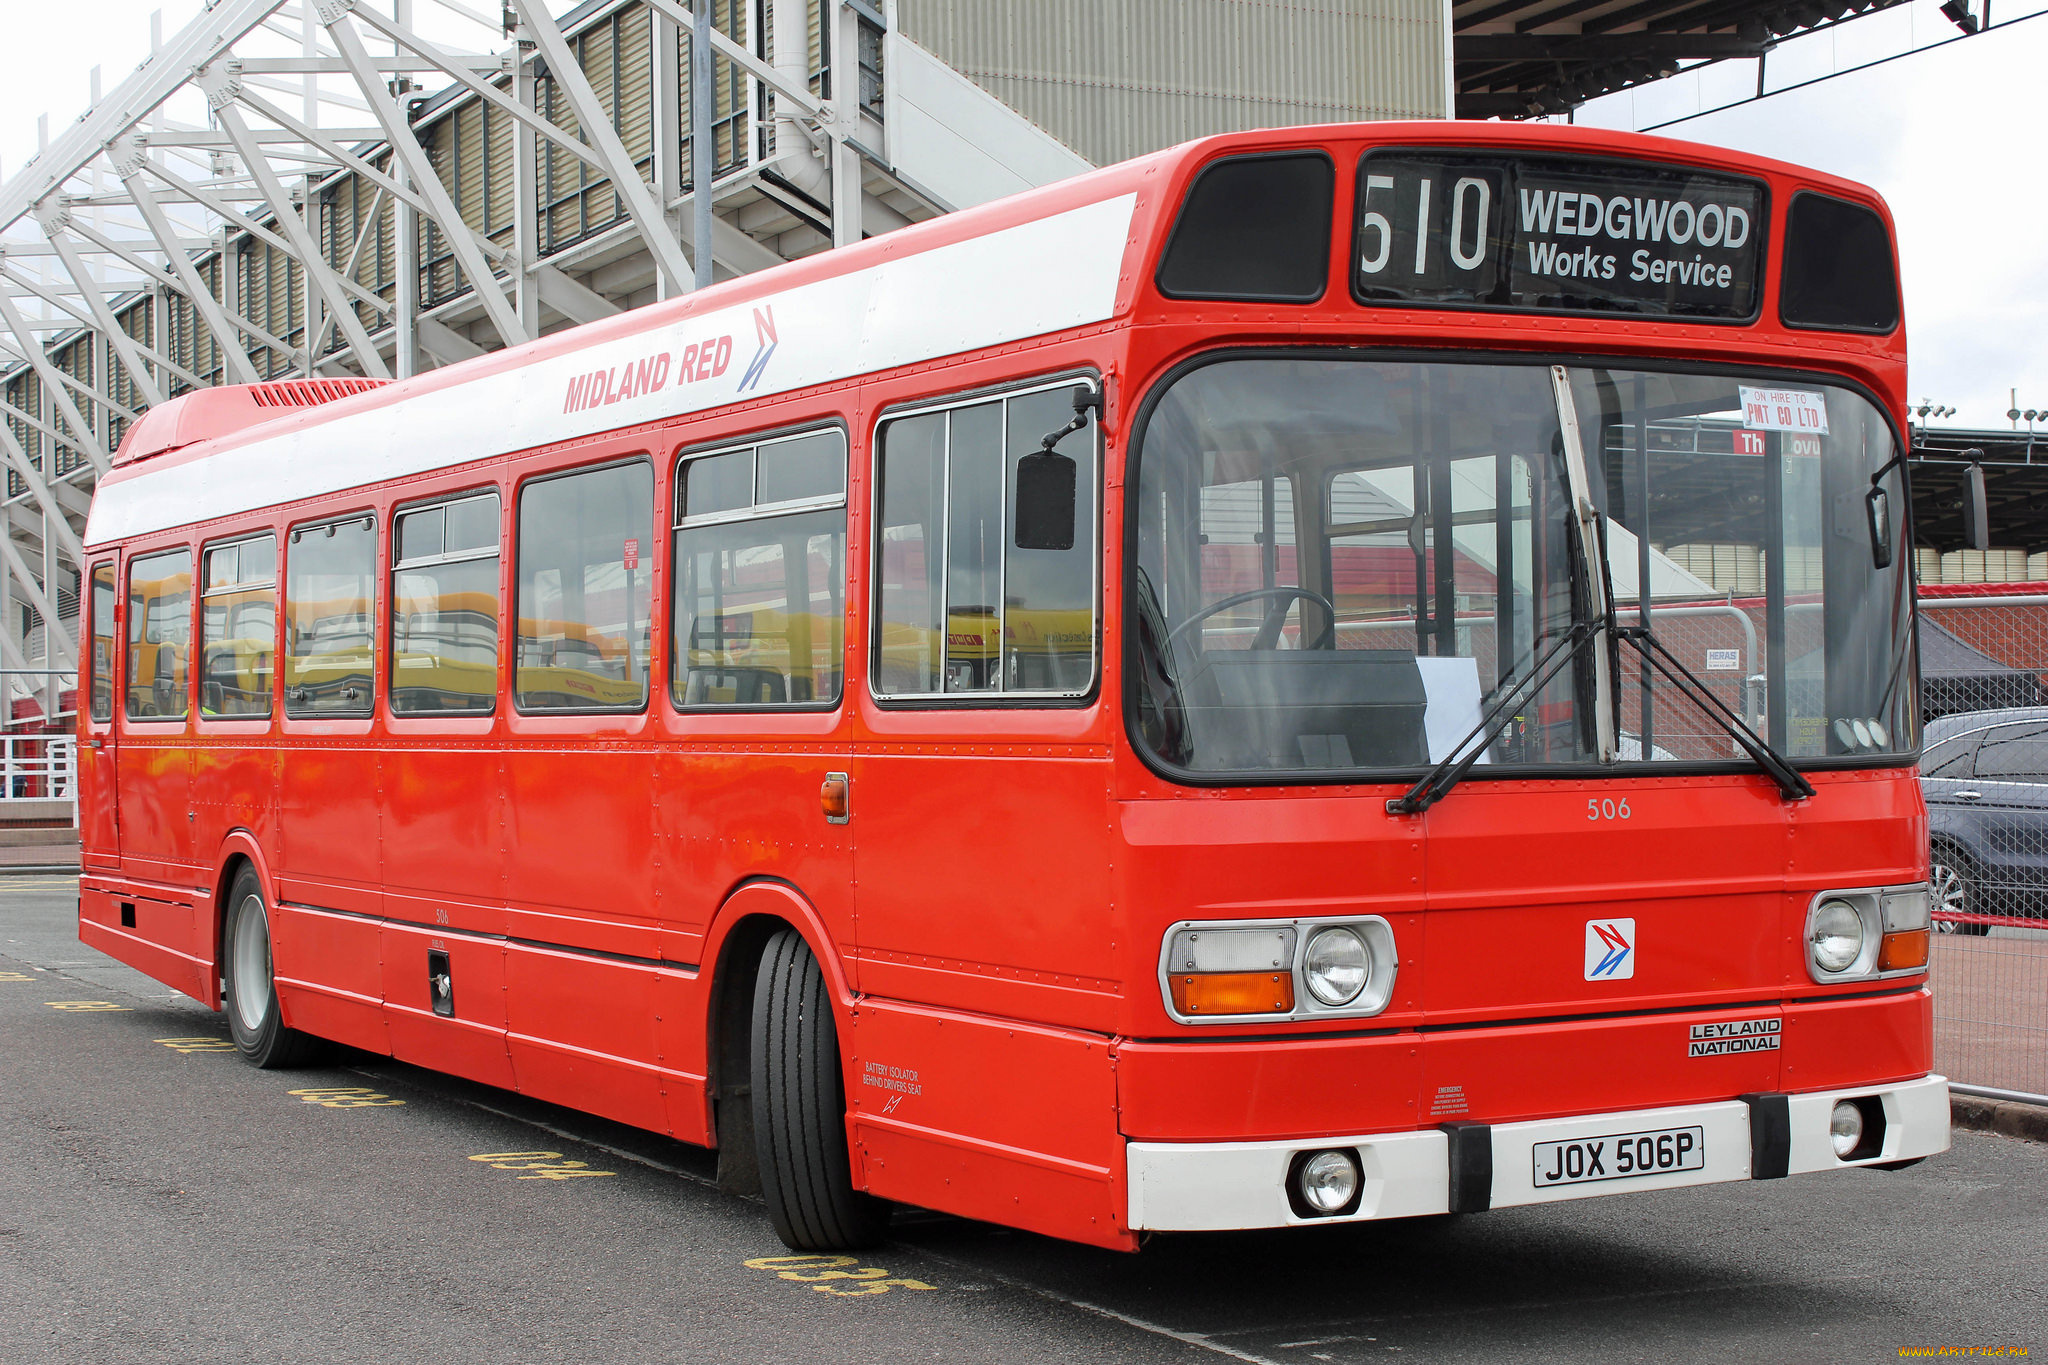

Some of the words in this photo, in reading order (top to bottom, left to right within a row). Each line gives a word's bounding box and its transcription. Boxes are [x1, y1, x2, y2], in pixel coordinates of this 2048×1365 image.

[1360, 174, 1491, 275] 510
[1520, 188, 1751, 249] WEDGWOOD
[1528, 241, 1617, 281] Works
[1629, 248, 1733, 289] Service
[563, 351, 671, 415] MIDLAND
[677, 335, 733, 386] RED
[1754, 391, 1766, 402] ON
[1770, 392, 1791, 403] HIRE
[1794, 393, 1807, 405] TO
[1747, 403, 1770, 424] PMT
[1777, 406, 1792, 426] CO
[1797, 407, 1819, 428] LTD
[1742, 433, 1765, 453] Th
[1709, 651, 1737, 660] HERAS
[1587, 797, 1631, 820] 506
[436, 908, 449, 925] 506
[1692, 1019, 1780, 1039] LEYLAND
[1690, 1036, 1779, 1056] NATIONAL
[865, 1061, 888, 1076] BATTERY
[889, 1066, 919, 1082] ISOLATOR
[863, 1073, 883, 1089] BEHIND
[884, 1078, 907, 1094] DRIVERS
[907, 1083, 922, 1097] SEAT
[1545, 1141, 1605, 1181] JOX
[1616, 1132, 1694, 1173] 506P
[742, 1255, 938, 1297] 035
